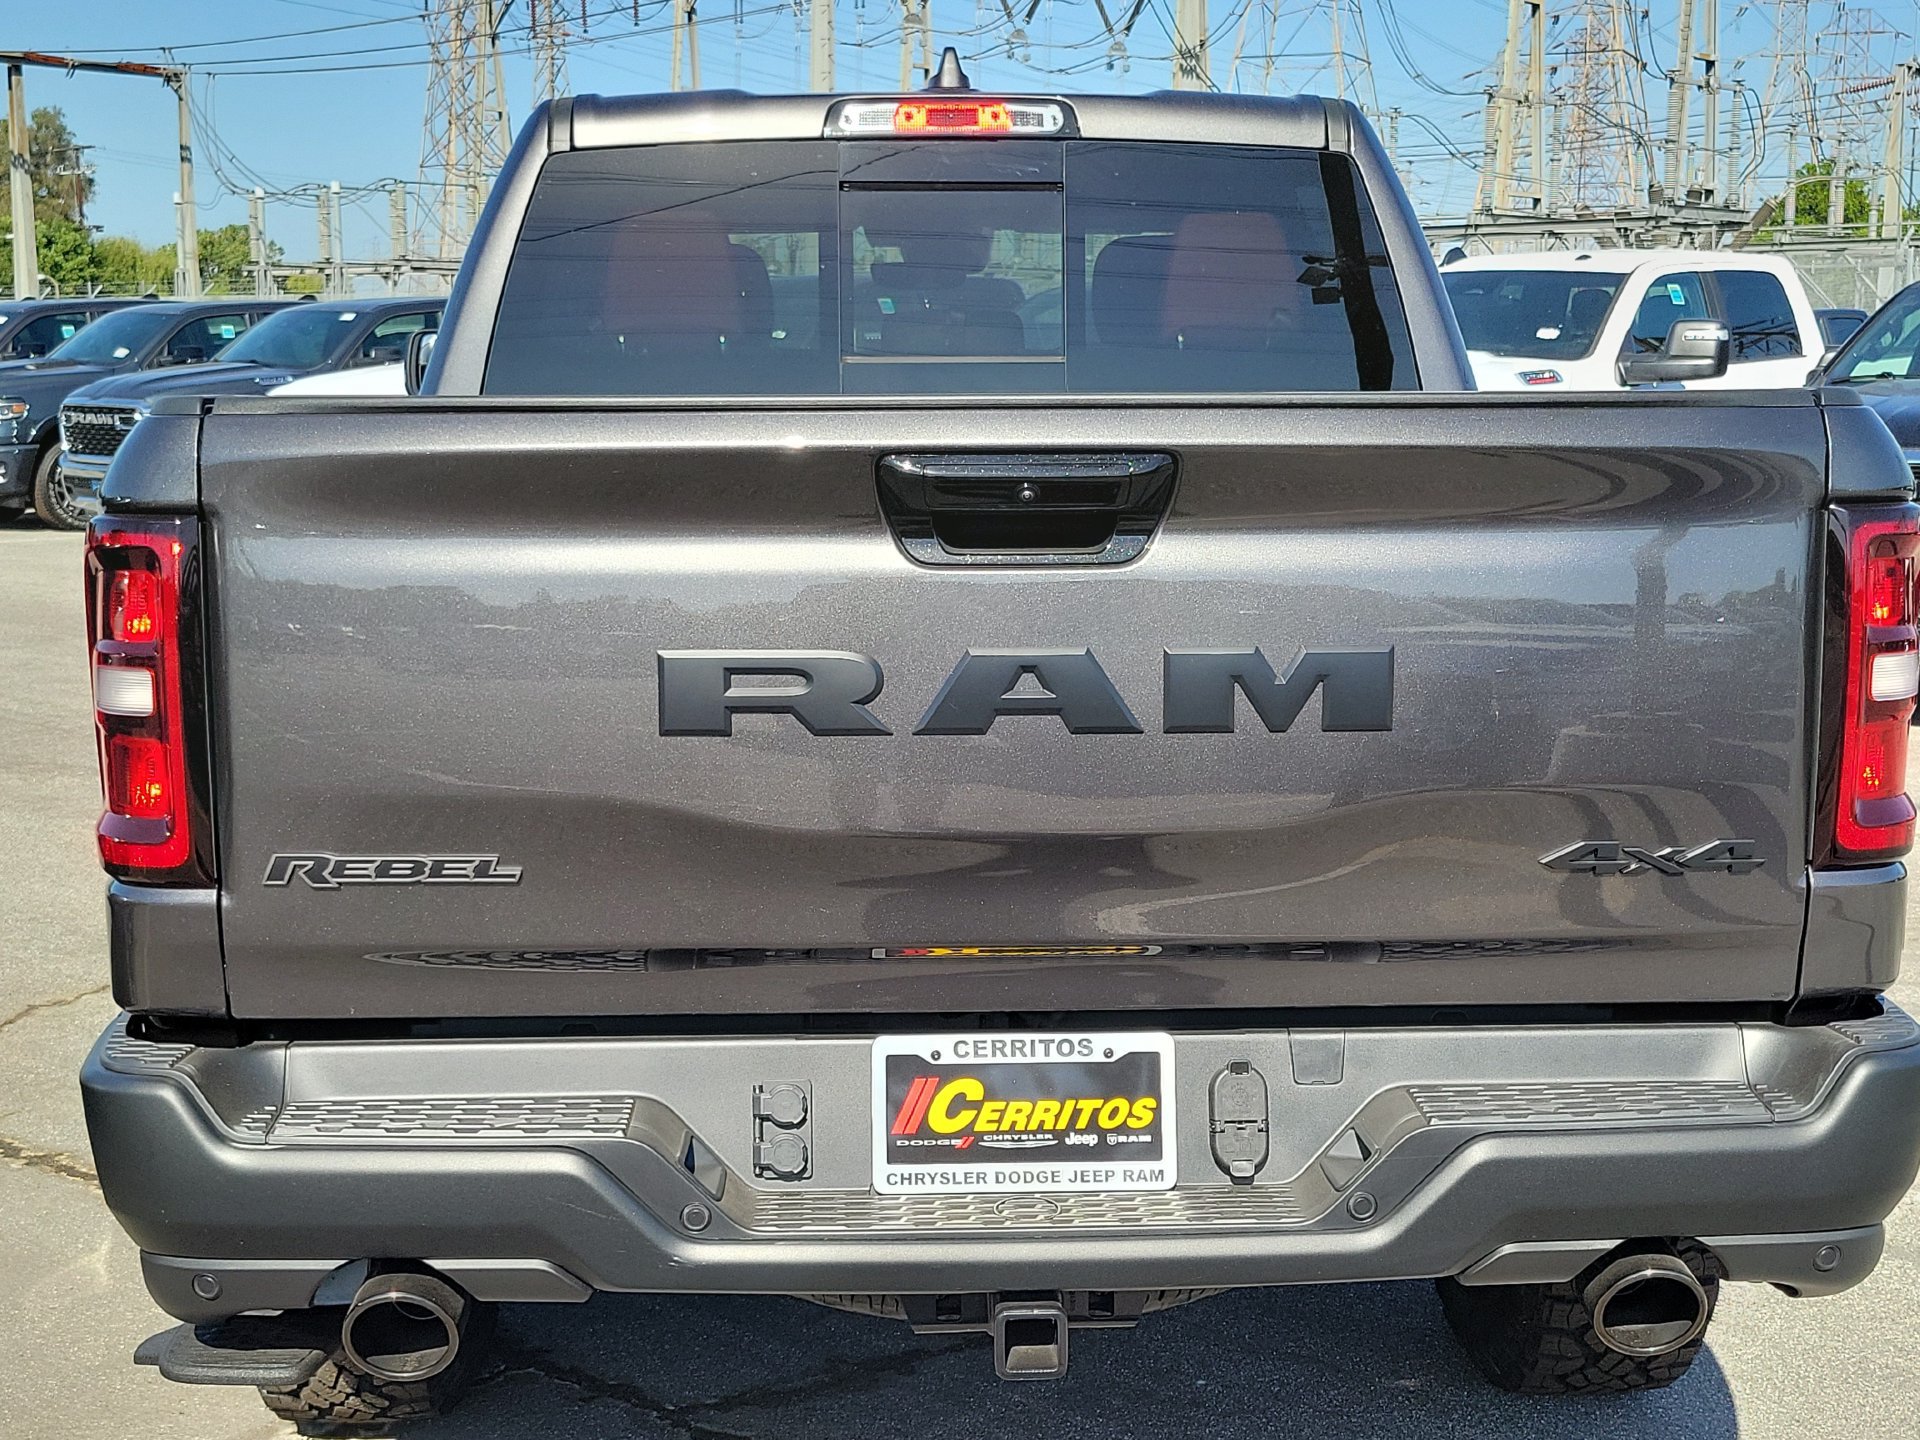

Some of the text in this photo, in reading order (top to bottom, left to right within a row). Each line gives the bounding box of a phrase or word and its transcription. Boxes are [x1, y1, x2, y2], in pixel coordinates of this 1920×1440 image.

[656, 644, 1396, 737] RAM
[263, 853, 523, 887] REBEL
[953, 1038, 1094, 1059] CERRITOS
[895, 1138, 965, 1147] DODGE
[1064, 1132, 1099, 1147] Jeep
[1117, 1134, 1152, 1143] RAM
[886, 1169, 1165, 1186] CHRYSLER DODGE JEEP RAM
